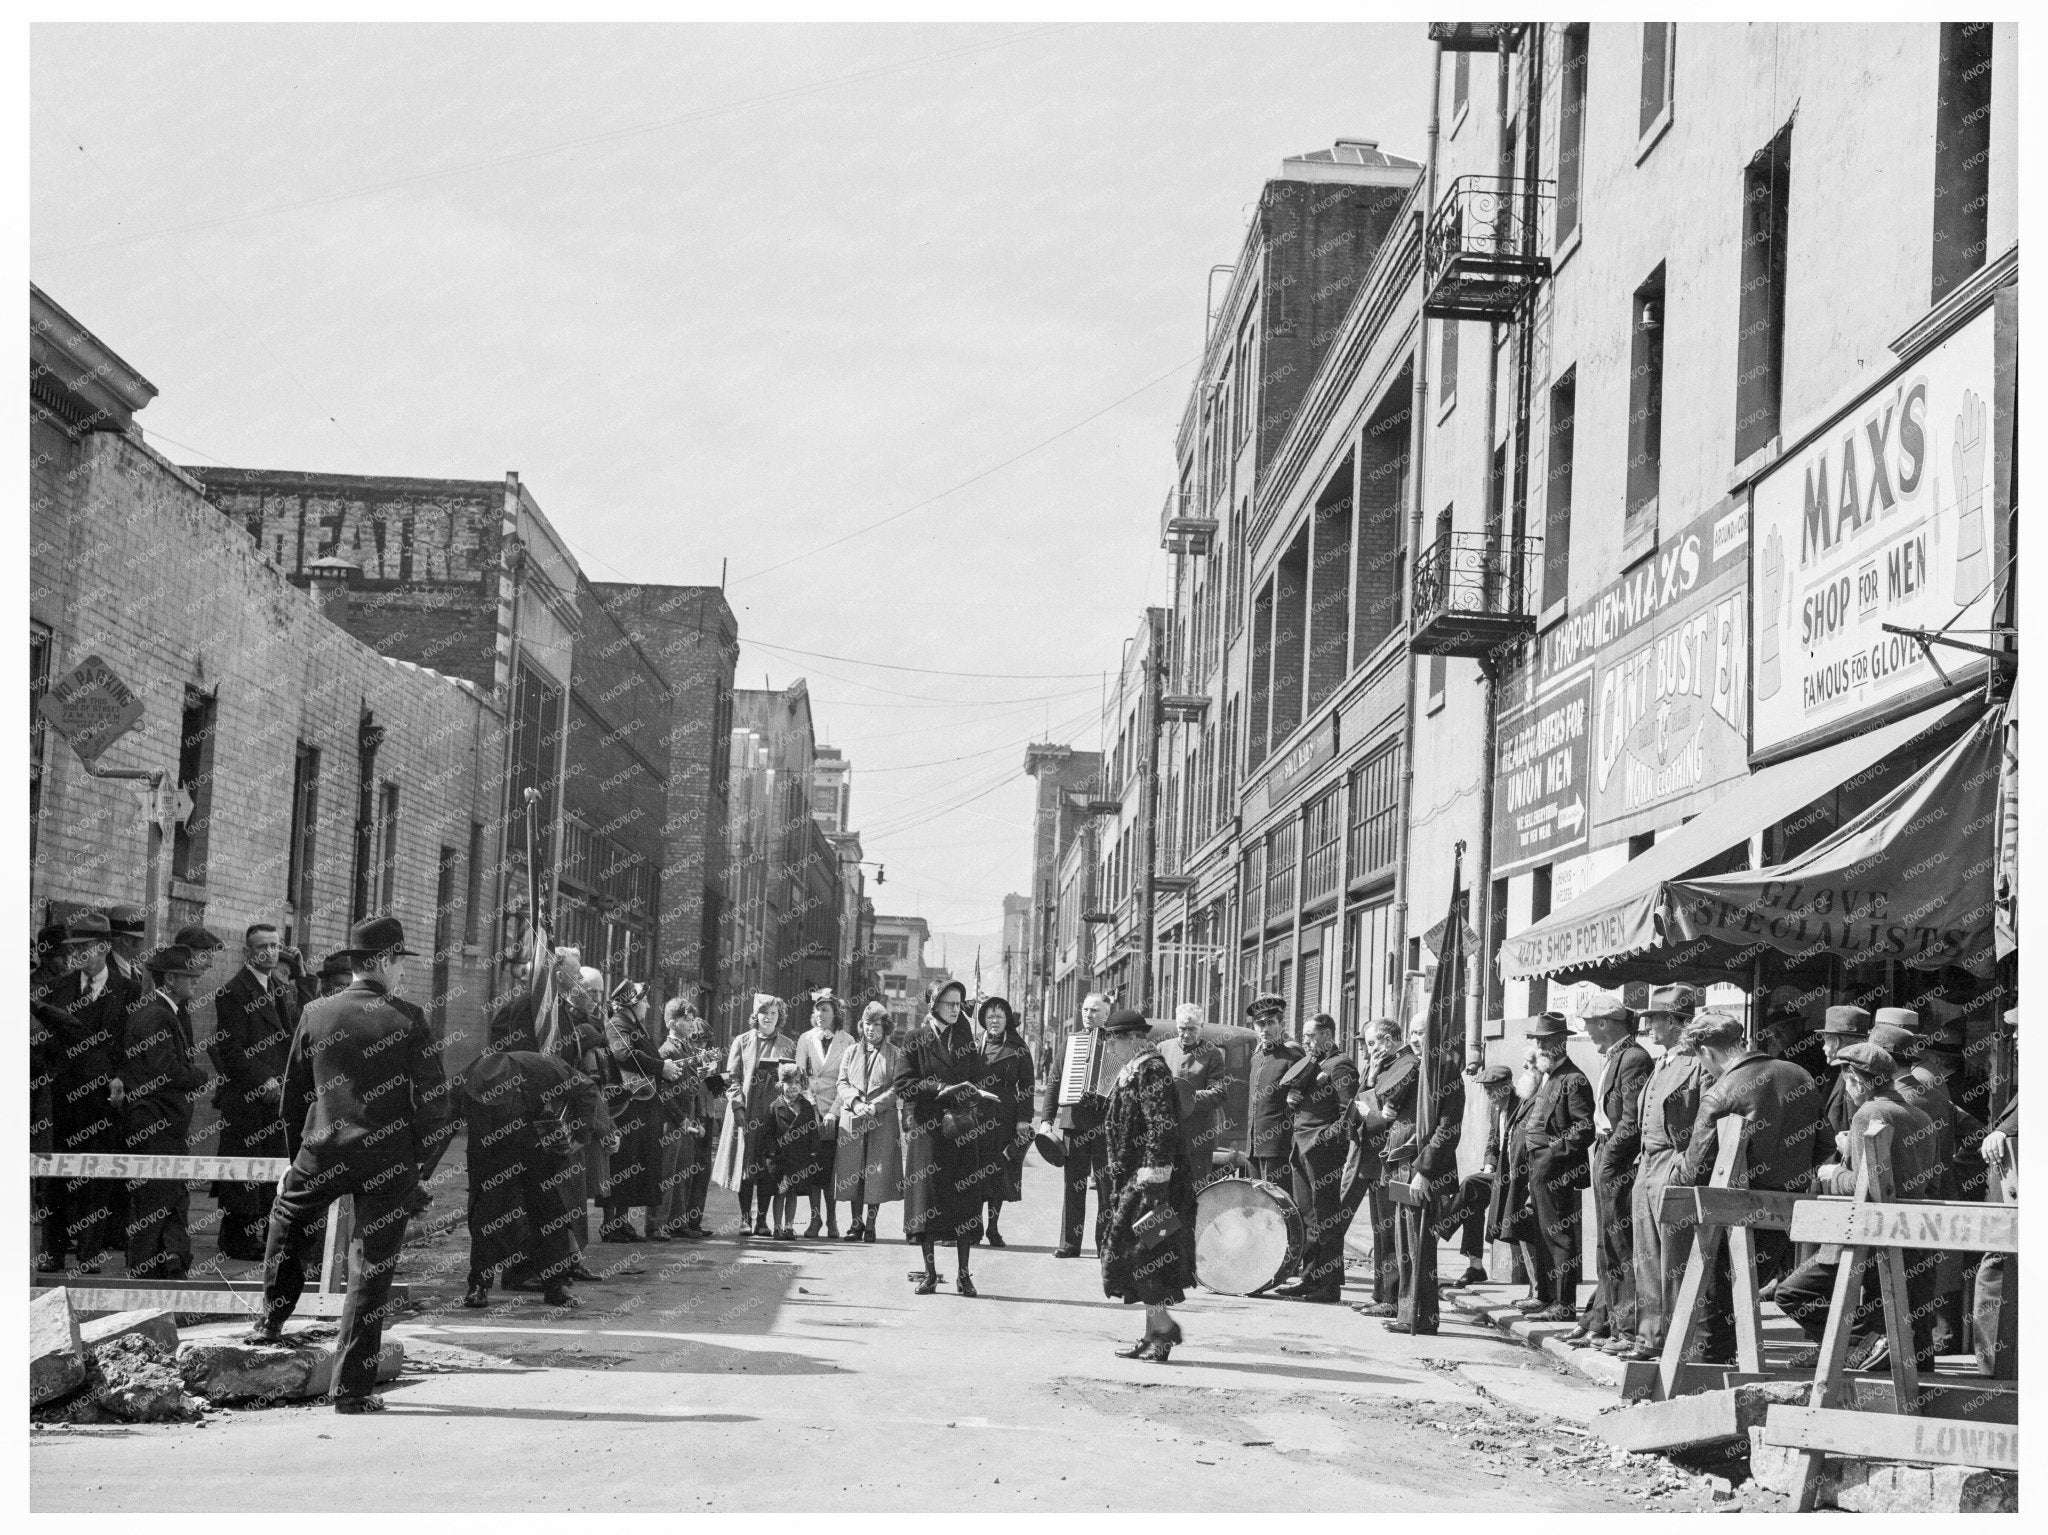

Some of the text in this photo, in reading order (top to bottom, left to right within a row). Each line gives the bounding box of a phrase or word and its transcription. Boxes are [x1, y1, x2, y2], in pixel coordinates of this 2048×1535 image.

[1801, 382, 1927, 566] MAX'S
[1803, 532, 1926, 645] SHOP FOR MEN
[1542, 638, 1549, 679] A
[1553, 615, 1581, 672] SHOP
[1582, 611, 1594, 651] FOR
[1656, 611, 1708, 702] BUST
[52, 668, 134, 708] NO PARKING
[1803, 659, 1849, 709] FAMOUS
[1852, 655, 1868, 684] FOR
[1566, 697, 1584, 742] FOR
[1508, 746, 1572, 813] UNION MEN
[1760, 881, 1889, 921] GLOVE
[1547, 931, 1571, 963] SHOP
[1577, 922, 1598, 957] FOR
[1601, 912, 1627, 950] MEN
[1694, 900, 1973, 960] SPECIALISTS
[111, 1156, 231, 1181] STREET
